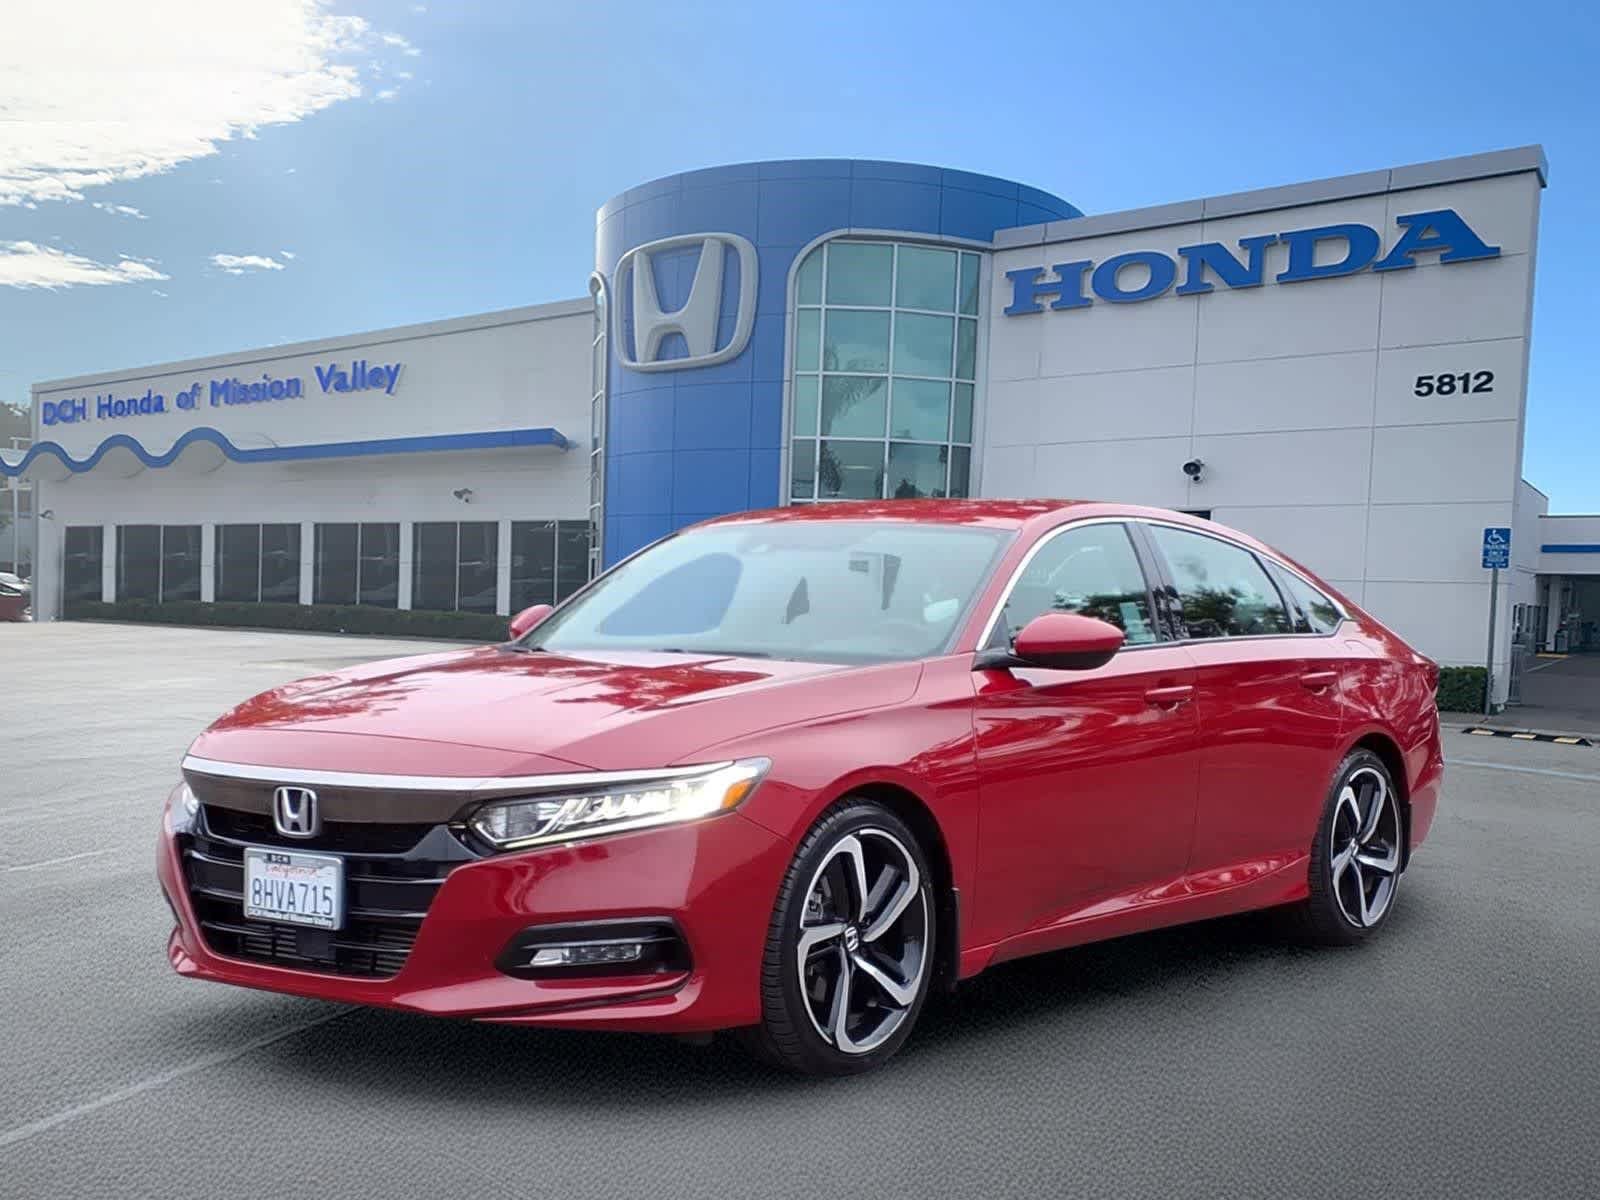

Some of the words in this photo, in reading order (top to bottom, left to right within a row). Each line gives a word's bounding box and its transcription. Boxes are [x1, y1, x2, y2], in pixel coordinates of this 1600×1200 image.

[1003, 208, 1501, 316] HONDA
[43, 398, 86, 426] DCH
[97, 391, 165, 419] Honda
[176, 383, 202, 410] of
[211, 374, 302, 407] Mission
[315, 360, 402, 394] Valley
[1414, 370, 1494, 397] 5812
[252, 878, 333, 916] 8HVA715
